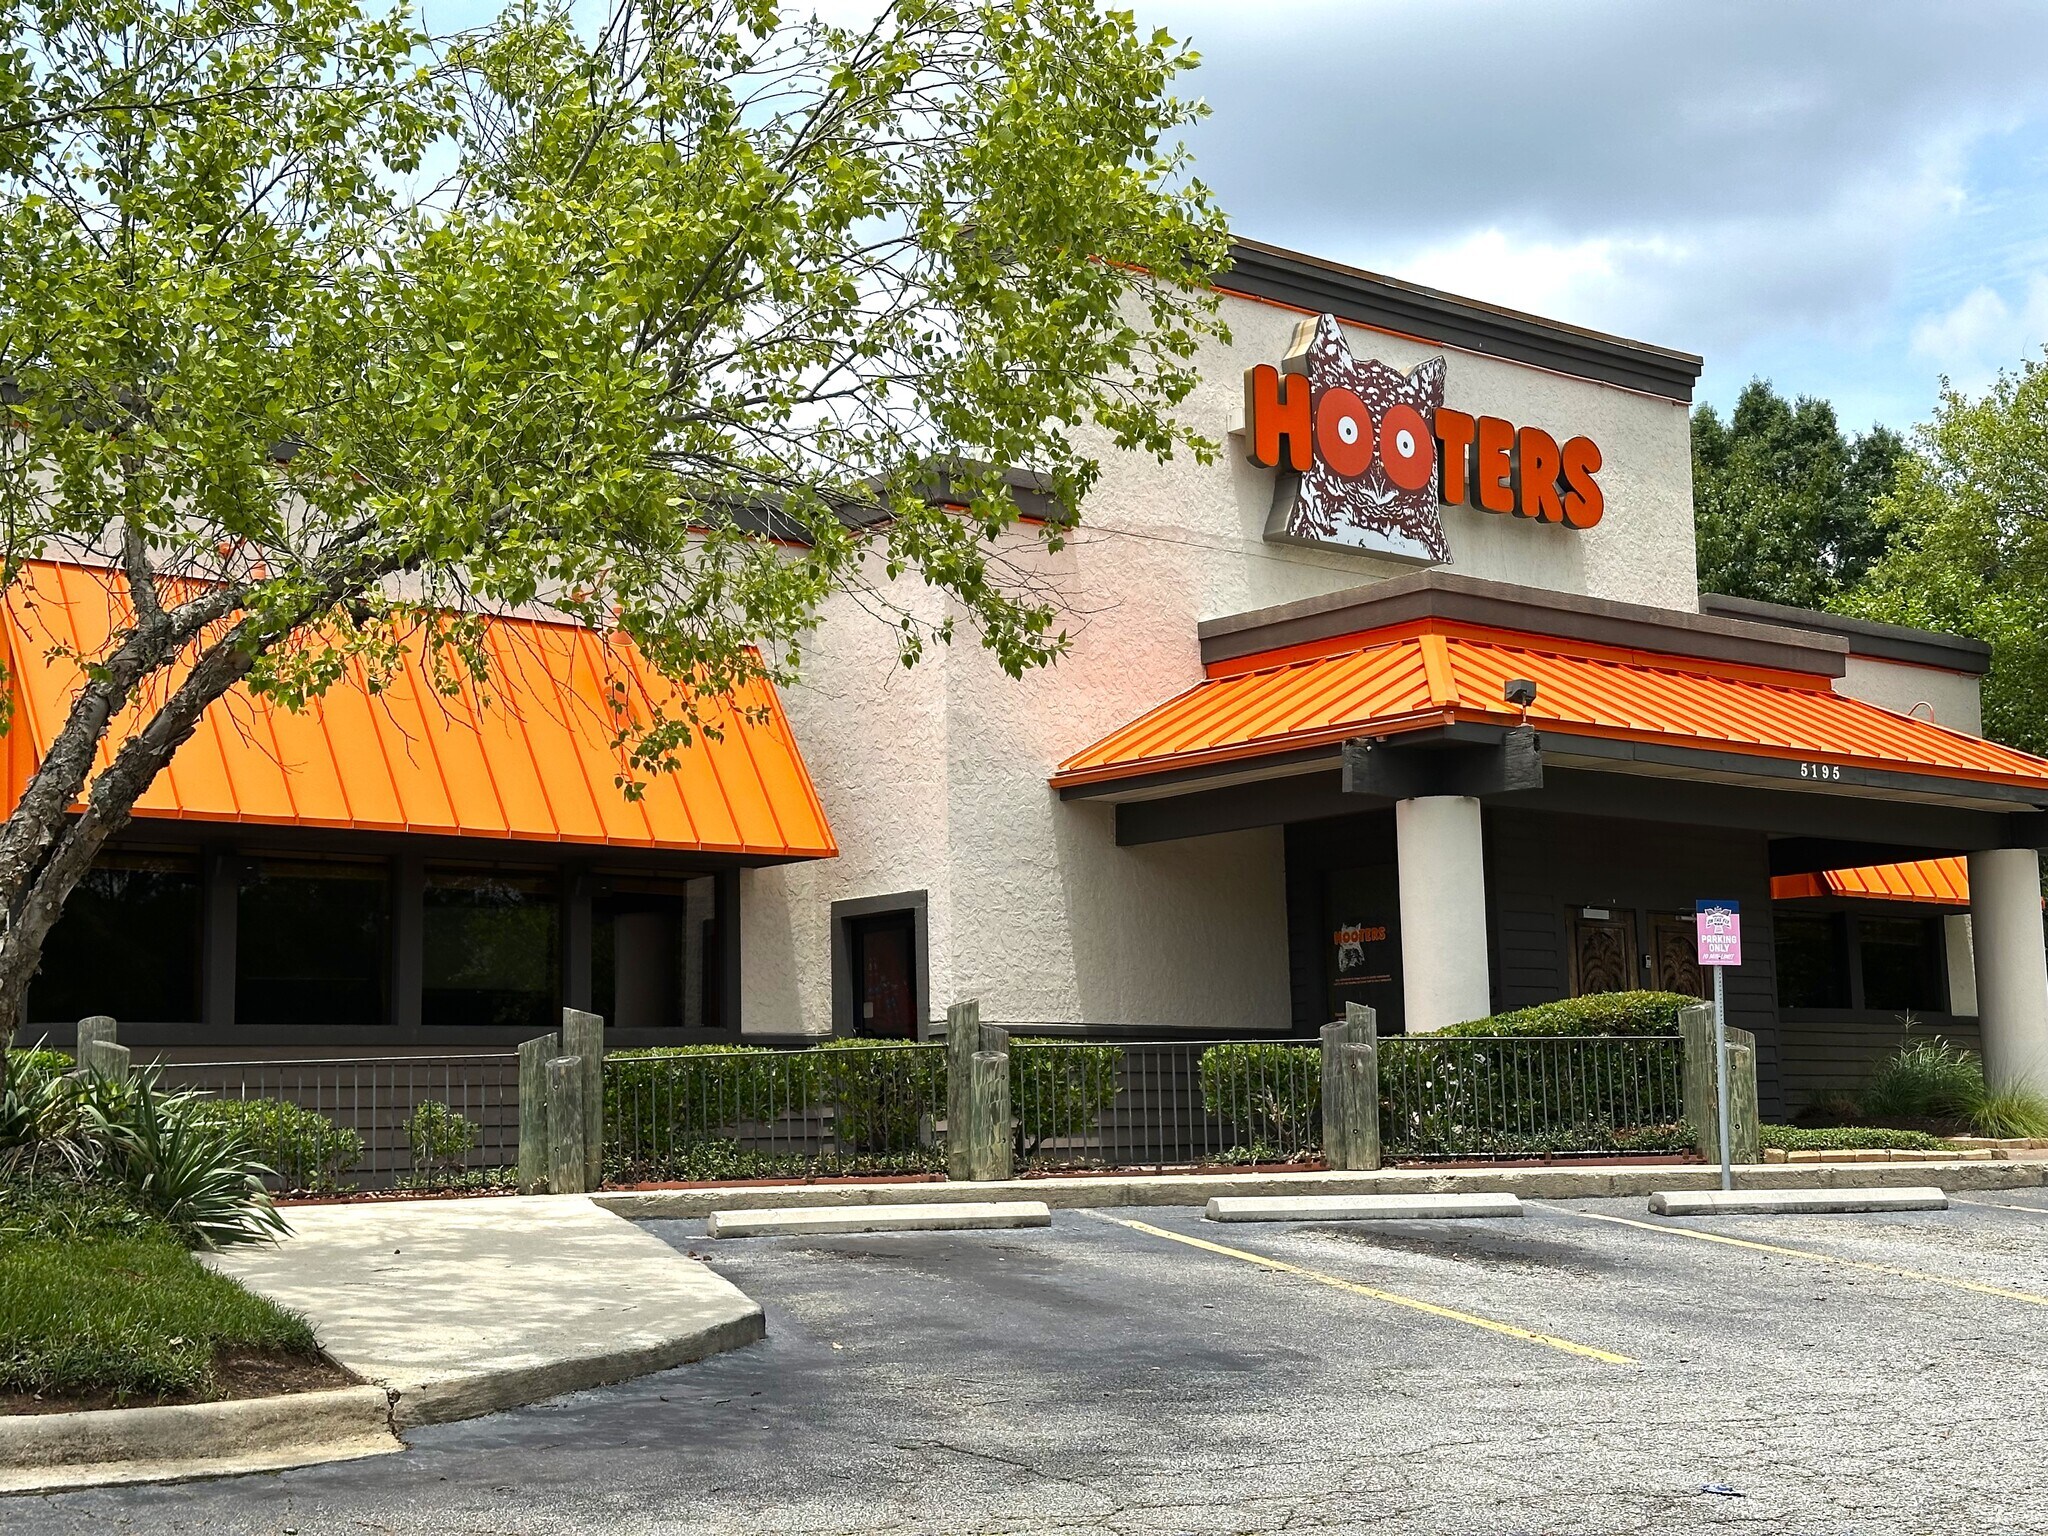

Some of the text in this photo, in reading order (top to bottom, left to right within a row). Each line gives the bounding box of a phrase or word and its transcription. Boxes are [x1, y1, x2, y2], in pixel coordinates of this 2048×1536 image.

[1250, 363, 1604, 529] HOOTERS
[1801, 763, 1840, 780] 5195
[1333, 926, 1386, 945] HOOTERS
[1702, 935, 1736, 944] PARKING
[1709, 944, 1730, 952] ONLY
